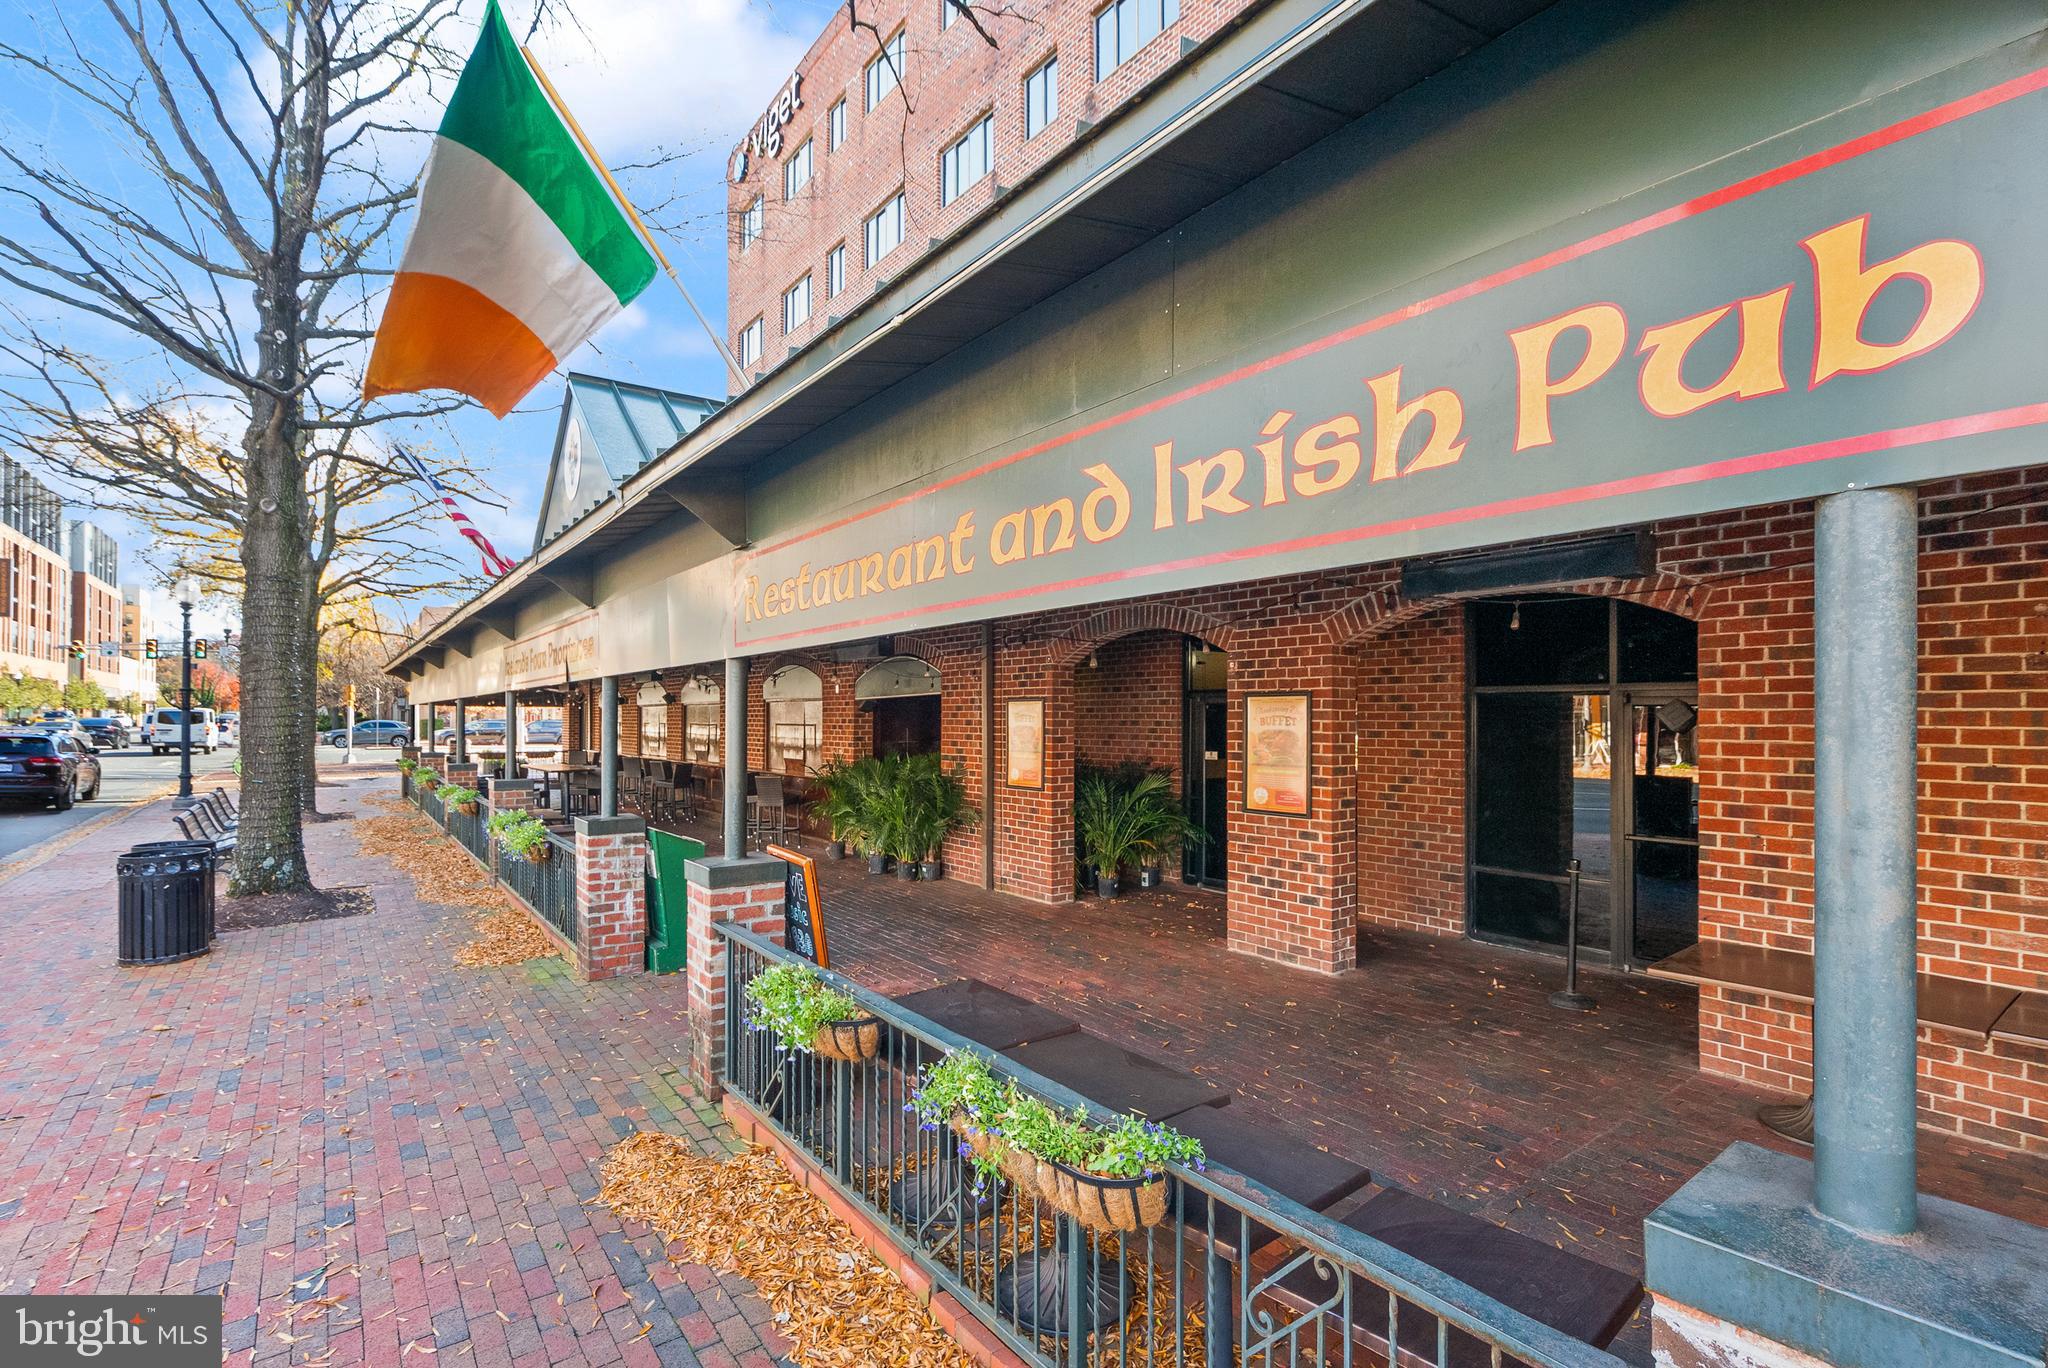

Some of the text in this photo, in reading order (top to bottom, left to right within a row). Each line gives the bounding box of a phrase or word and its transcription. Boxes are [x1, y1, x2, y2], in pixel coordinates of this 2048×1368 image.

[752, 72, 803, 159] viget
[744, 213, 1986, 624] Restaurant and Irish Pub
[1259, 715, 1297, 727] BUFFET
